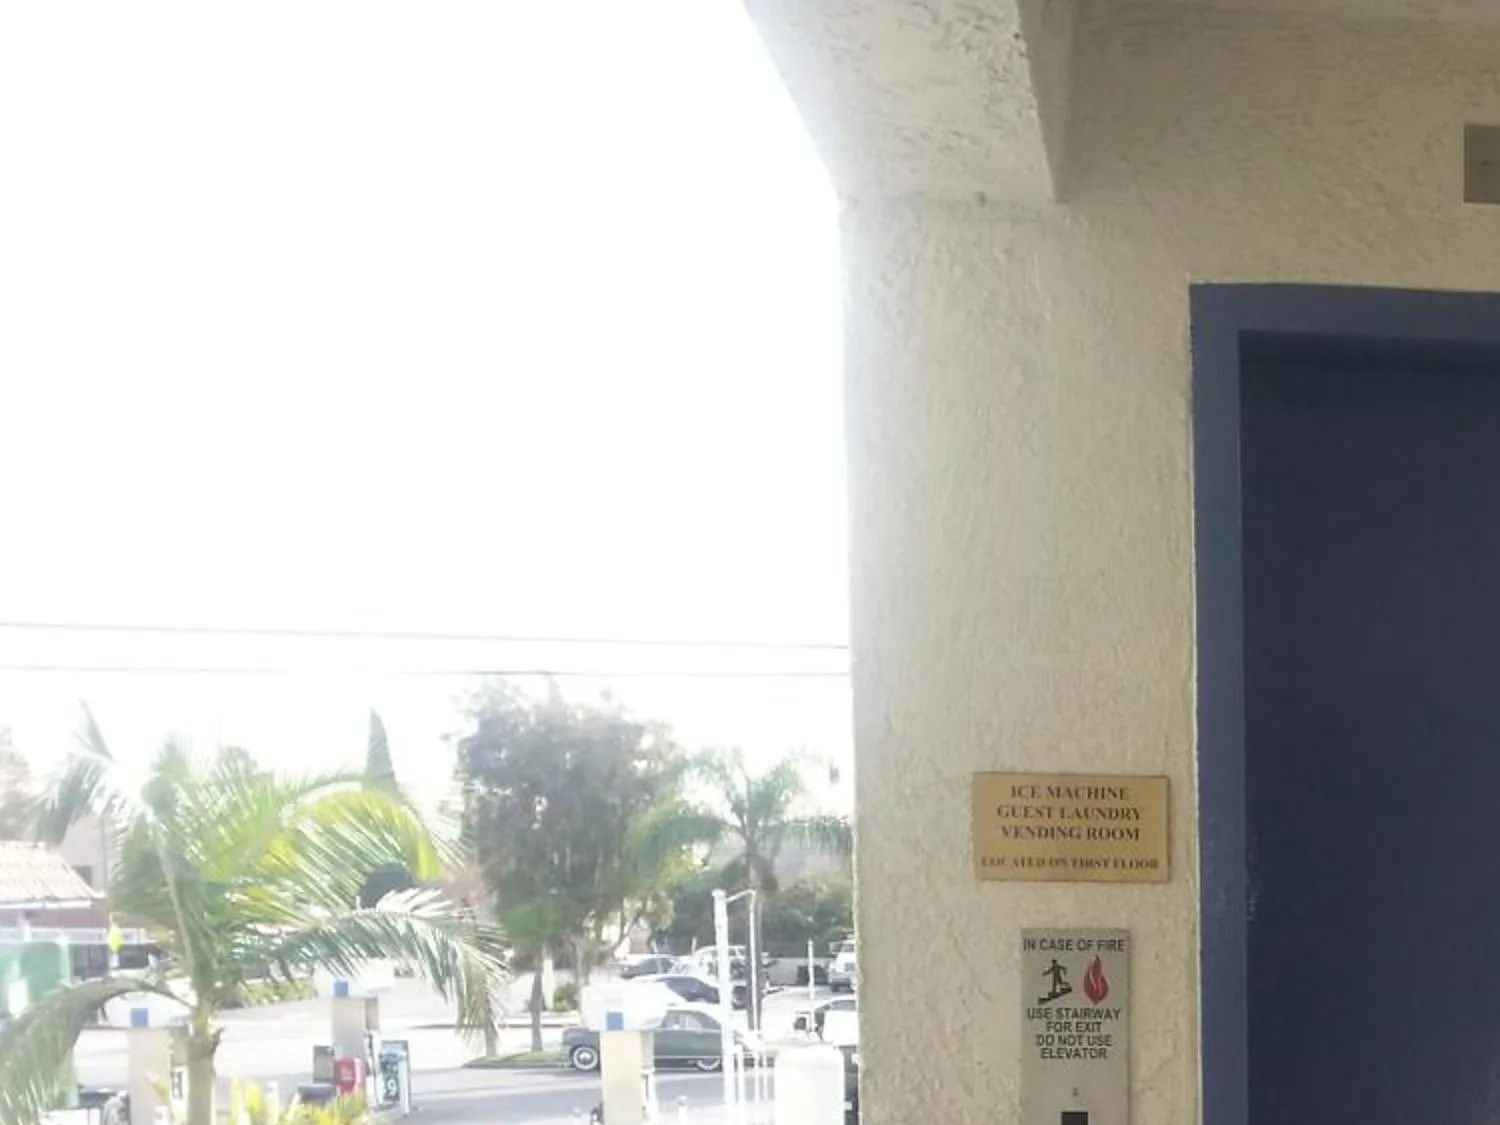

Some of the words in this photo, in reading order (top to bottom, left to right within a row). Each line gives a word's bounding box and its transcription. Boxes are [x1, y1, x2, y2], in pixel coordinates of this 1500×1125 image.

[1011, 785, 1041, 799] ICE
[1047, 785, 1130, 801] MACHINE
[997, 804, 1055, 819] GUEST
[1060, 806, 1141, 821] LAUNDRY
[1000, 825, 1081, 840] VENDING
[1087, 826, 1140, 841] ROOM
[1071, 857, 1109, 869] FIRST
[1113, 858, 1159, 870] FLOOR
[1023, 939, 1036, 951] IN
[1039, 938, 1073, 951] CASE
[1076, 938, 1093, 951] OF
[1098, 939, 1125, 952] FIRE
[1027, 1007, 1052, 1019] USE
[1056, 1007, 1120, 1020] STAIRWAY
[1046, 1021, 1072, 1032] FOR
[1075, 1021, 1102, 1033] EXIT
[1036, 1034, 1055, 1046] DO
[1058, 1034, 1085, 1046] NOT
[1088, 1034, 1112, 1047] USE
[1040, 1047, 1107, 1059] ELEVATOR
